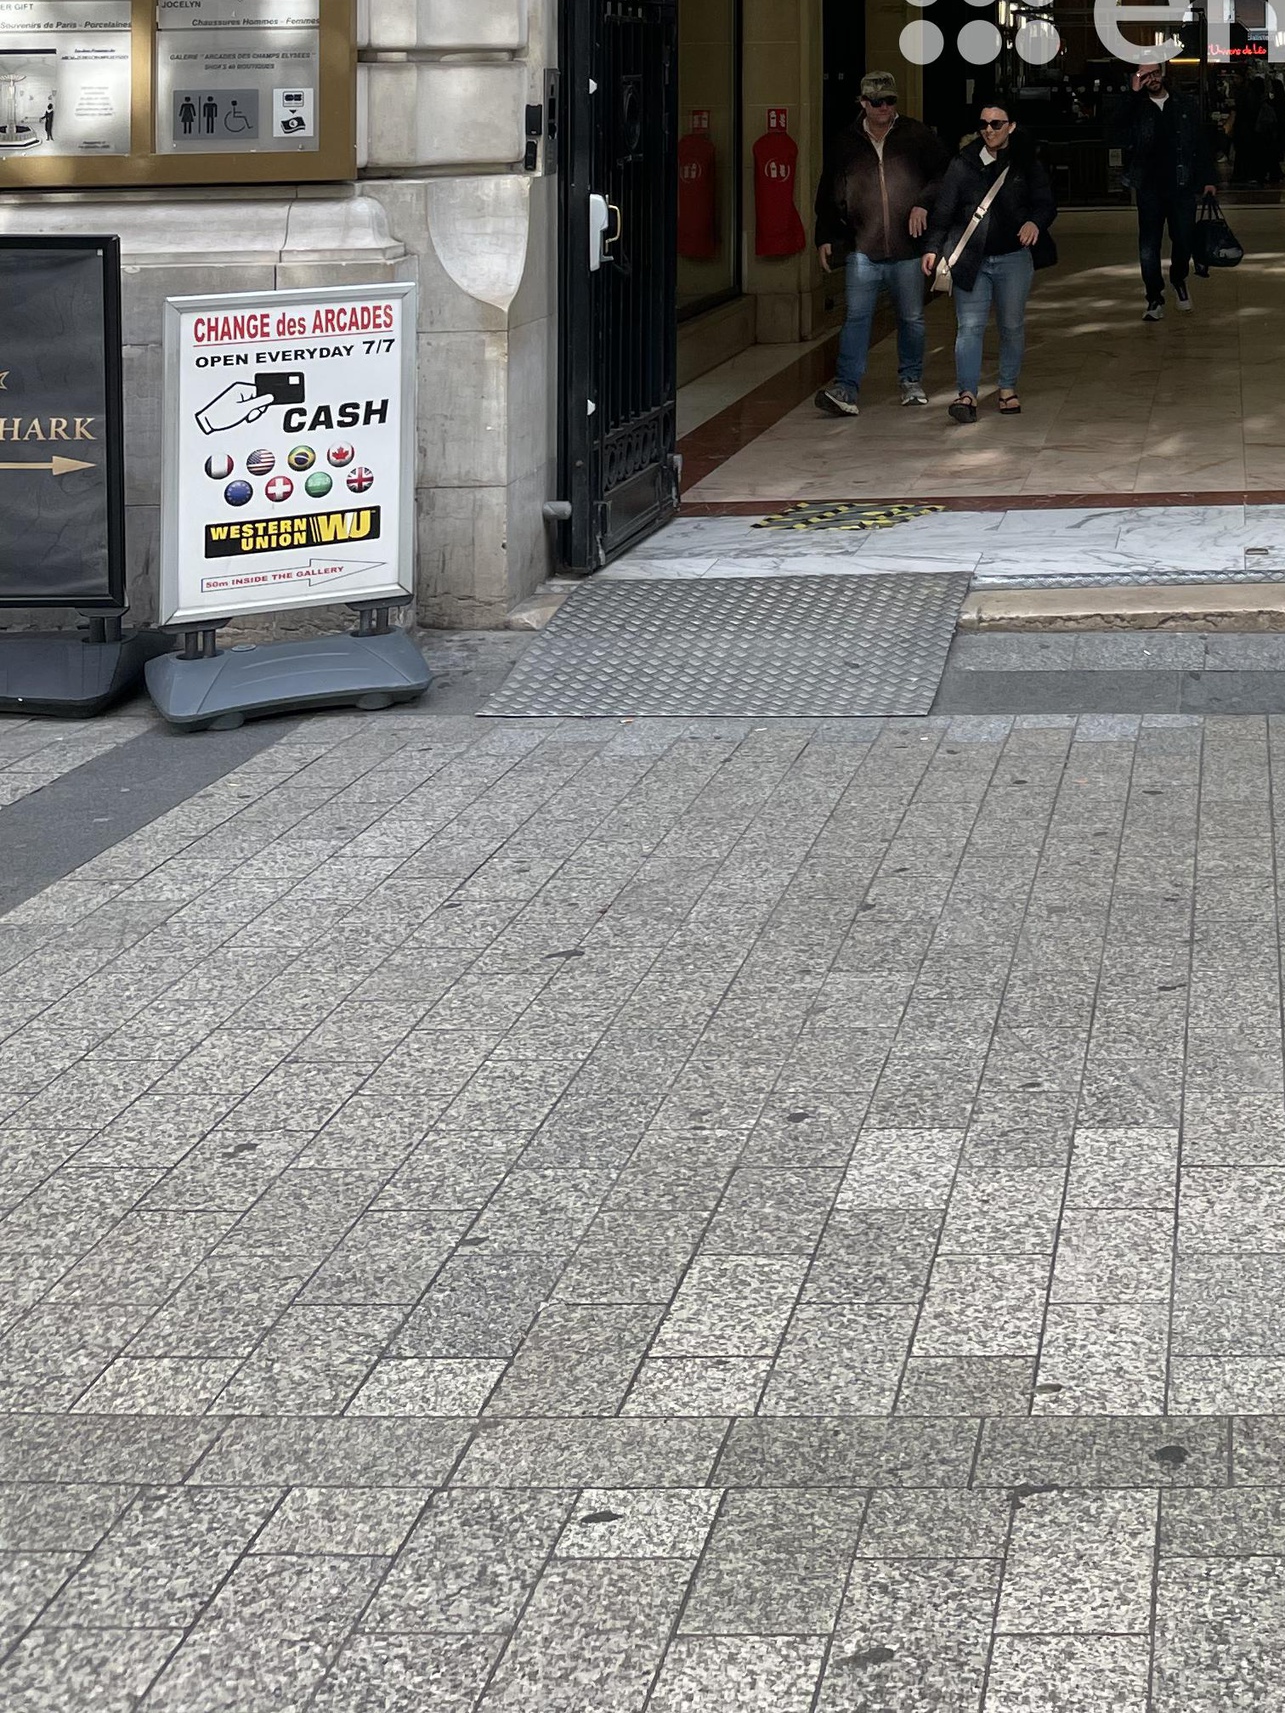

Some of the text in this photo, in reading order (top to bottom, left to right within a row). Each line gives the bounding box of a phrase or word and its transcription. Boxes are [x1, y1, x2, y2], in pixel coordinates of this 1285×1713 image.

[161, 0, 201, 9] JOCELYN
[194, 304, 394, 343] CHANGE des ARCADES
[195, 338, 396, 368] OPEN EVERYDAY 7/7
[283, 398, 390, 434] CASH
[210, 517, 307, 541] WESTERN
[241, 532, 307, 551] UNION
[205, 566, 345, 589] 50m INSIDE THE GALLERY
